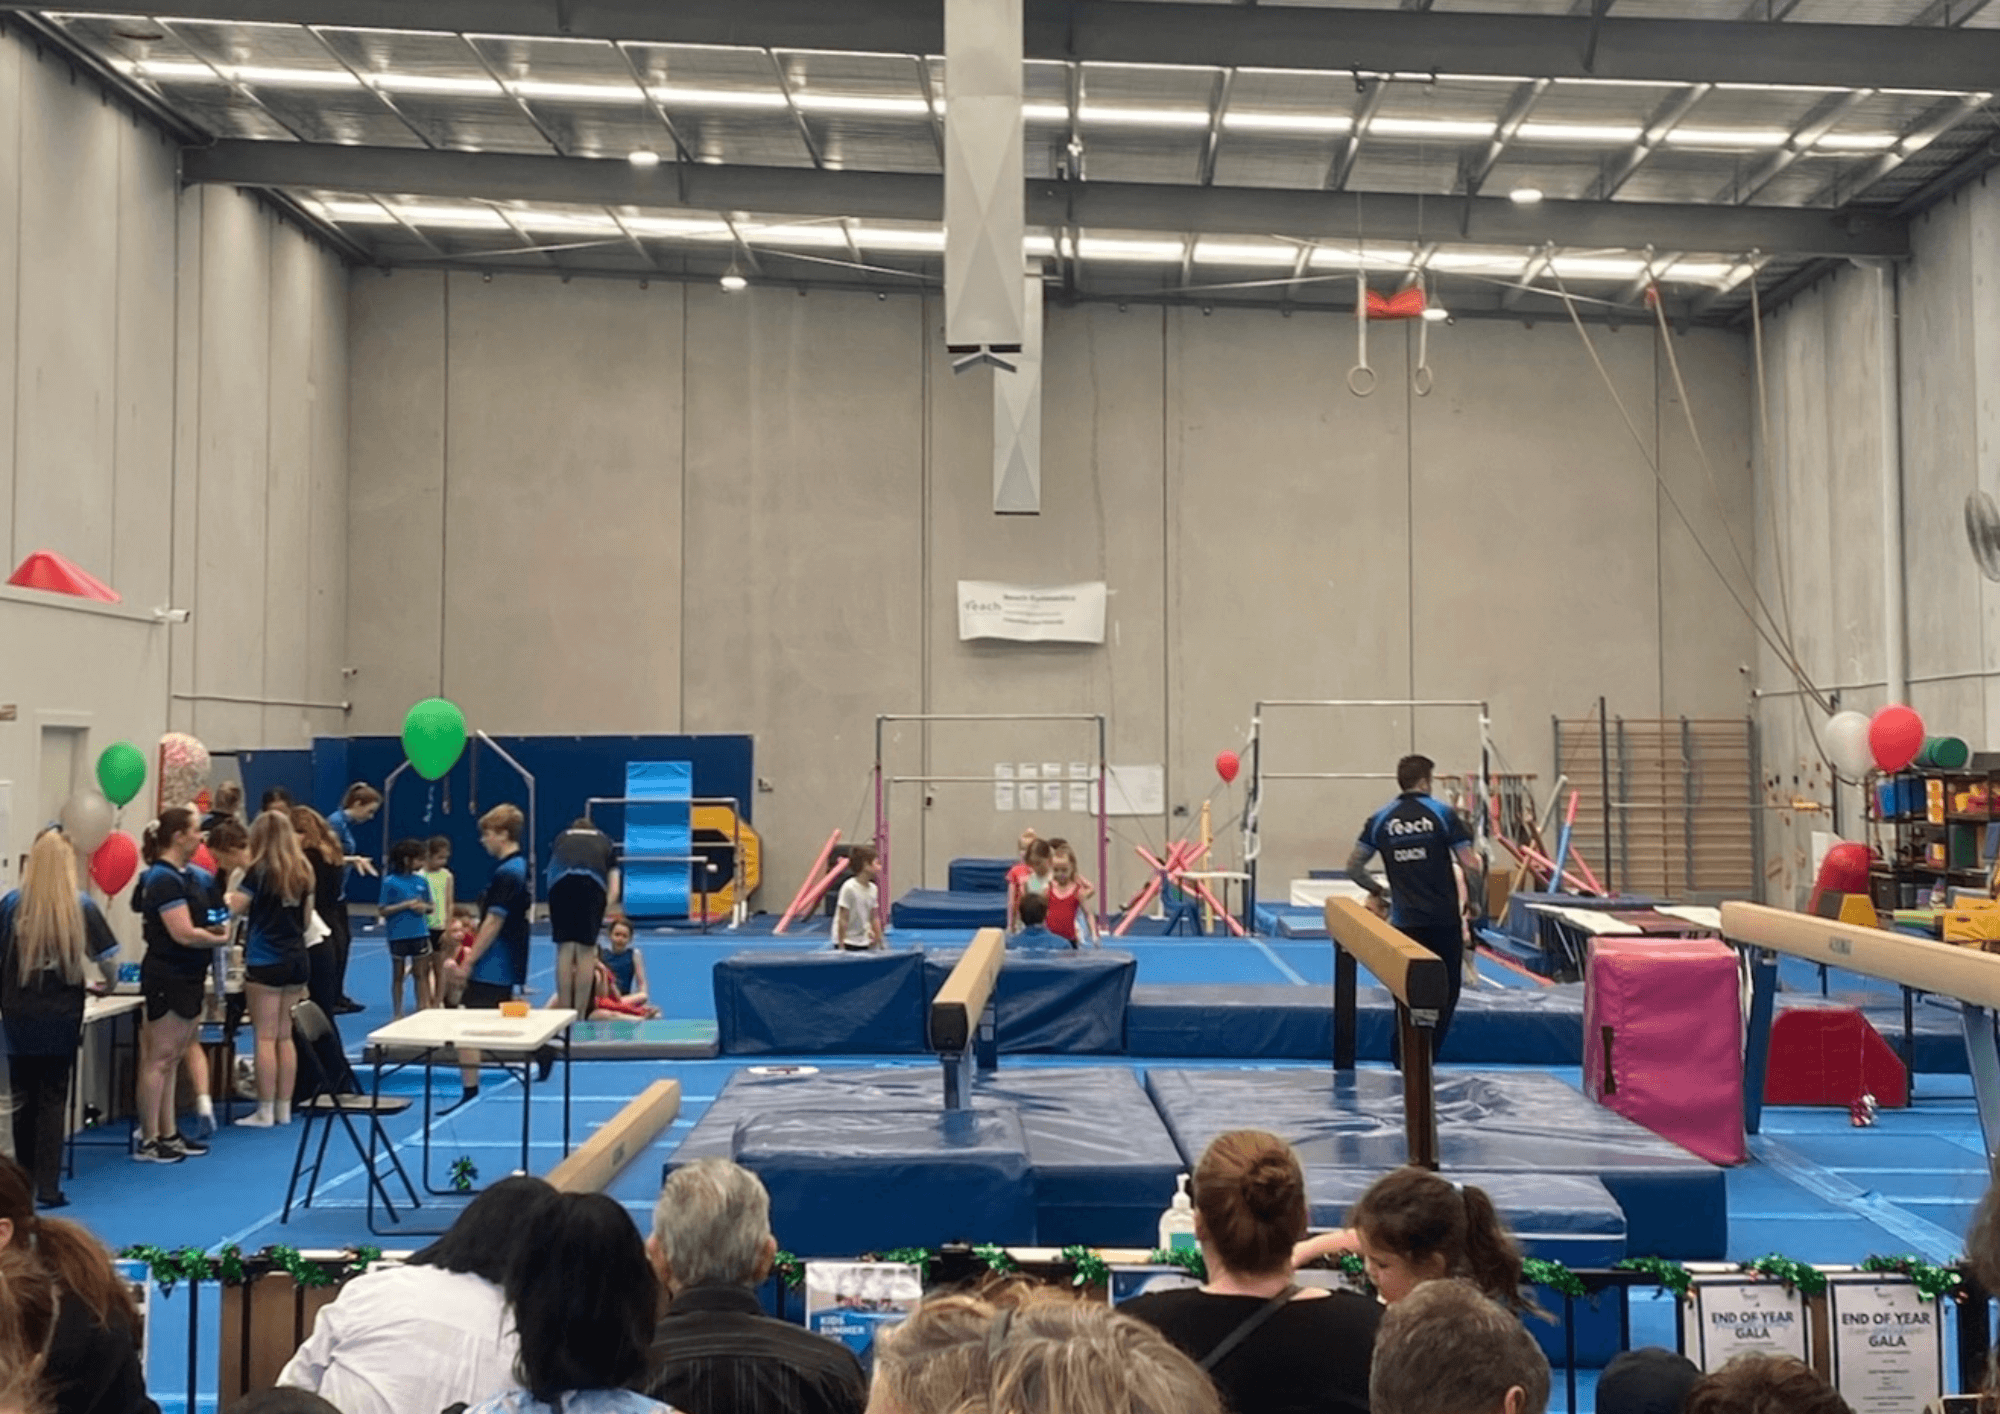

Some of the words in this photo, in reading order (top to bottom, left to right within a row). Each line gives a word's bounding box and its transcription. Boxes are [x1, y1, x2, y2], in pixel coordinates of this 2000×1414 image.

[1386, 816, 1434, 836] reach
[1394, 847, 1428, 862] COACH
[1711, 1312, 1738, 1323] END
[1740, 1312, 1758, 1323] OF
[1761, 1311, 1794, 1323] YEAR
[1842, 1313, 1870, 1324] END
[1873, 1313, 1891, 1324] OF
[1894, 1313, 1930, 1324] YEAR
[1735, 1328, 1771, 1338] GALA
[1869, 1335, 1906, 1347] GALA
